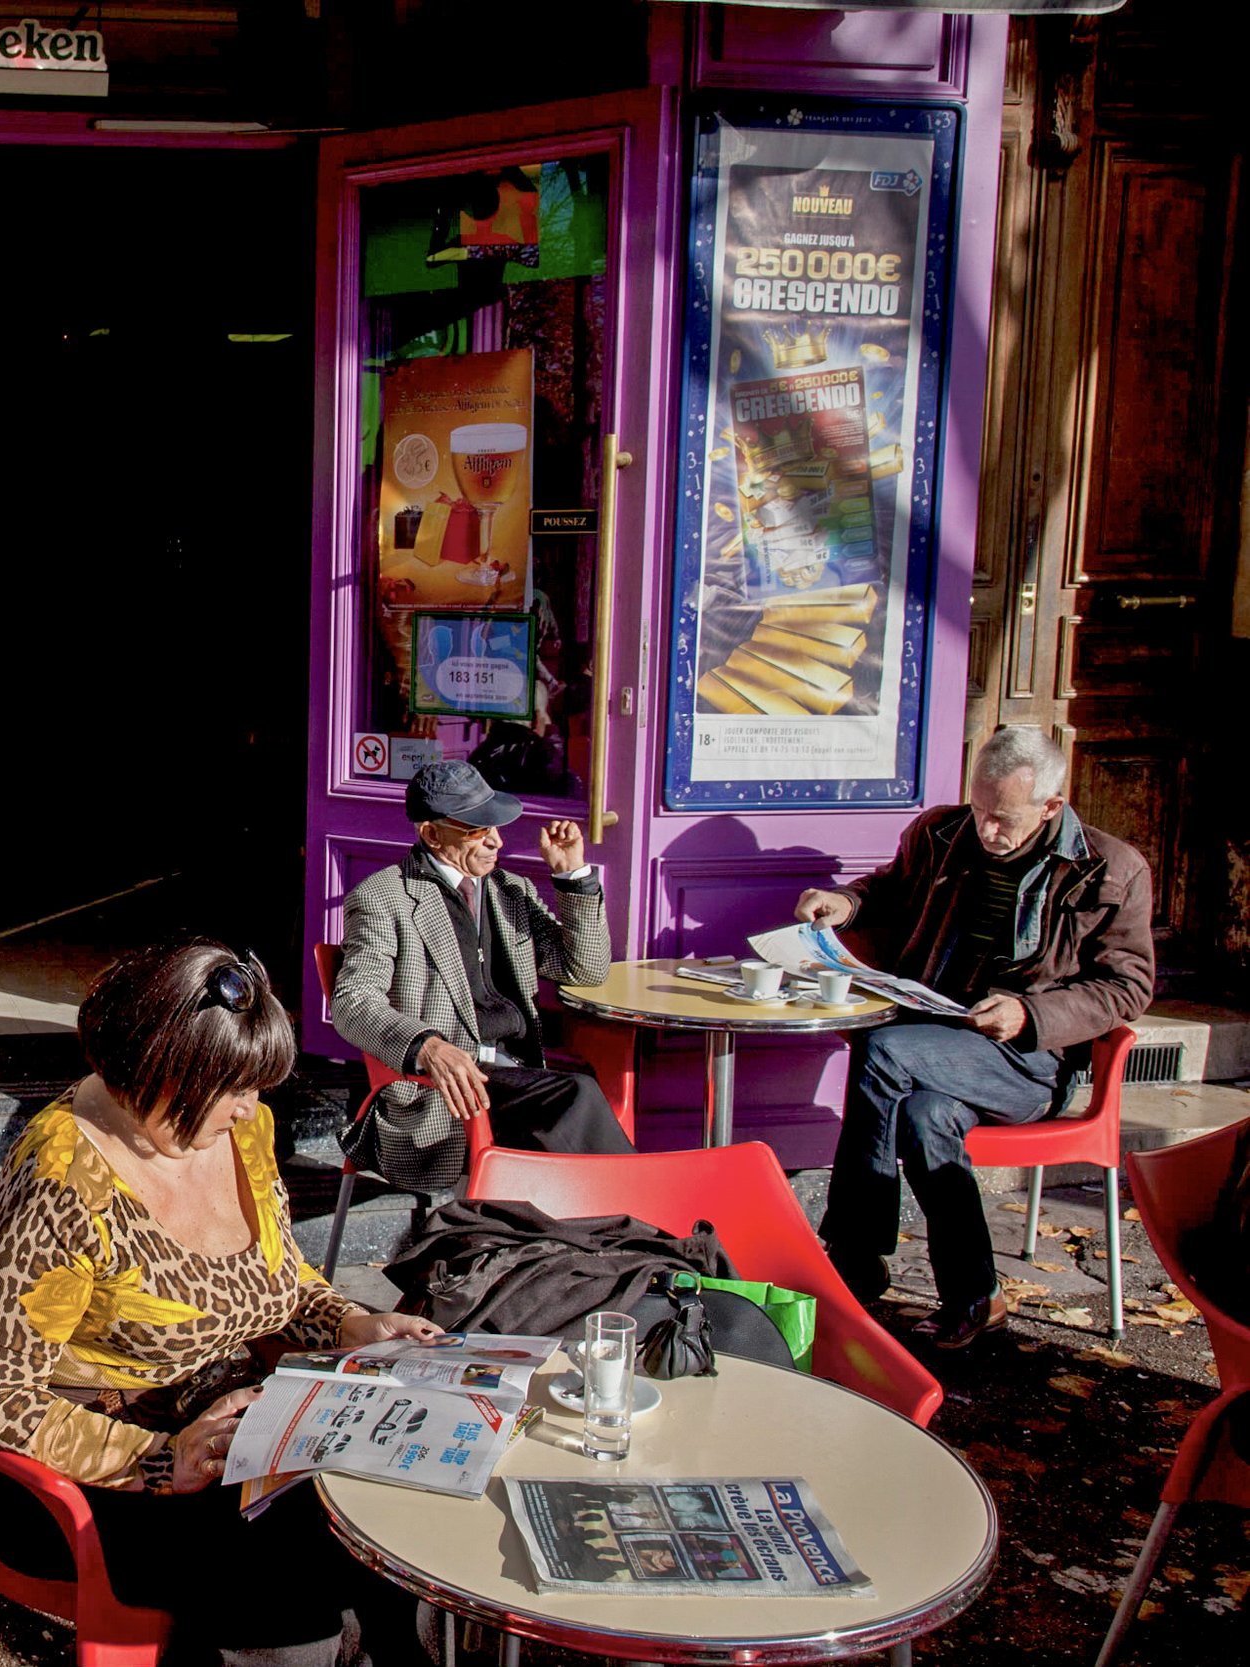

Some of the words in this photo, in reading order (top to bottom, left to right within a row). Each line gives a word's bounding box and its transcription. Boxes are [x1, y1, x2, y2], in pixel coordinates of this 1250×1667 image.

[873, 174, 899, 186] FDJ
[792, 196, 854, 215] NOUVEAU
[783, 232, 817, 245] GAGNEZ
[732, 277, 901, 316] CRESCENDO
[735, 382, 861, 424] CRESCENDO
[542, 516, 587, 527] POUSSEZ
[449, 671, 470, 684] 183
[474, 672, 495, 684] 151
[698, 734, 716, 746] 18+
[453, 1421, 471, 1440] TARD
[465, 1423, 483, 1442] PLUS
[454, 1450, 472, 1466] TROP
[724, 1482, 753, 1521] crève
[742, 1522, 762, 1537] les
[753, 1537, 788, 1582] écrans
[753, 1507, 773, 1524] La
[763, 1525, 797, 1556] santé
[770, 1482, 792, 1504] La
[782, 1508, 840, 1585] Provence
